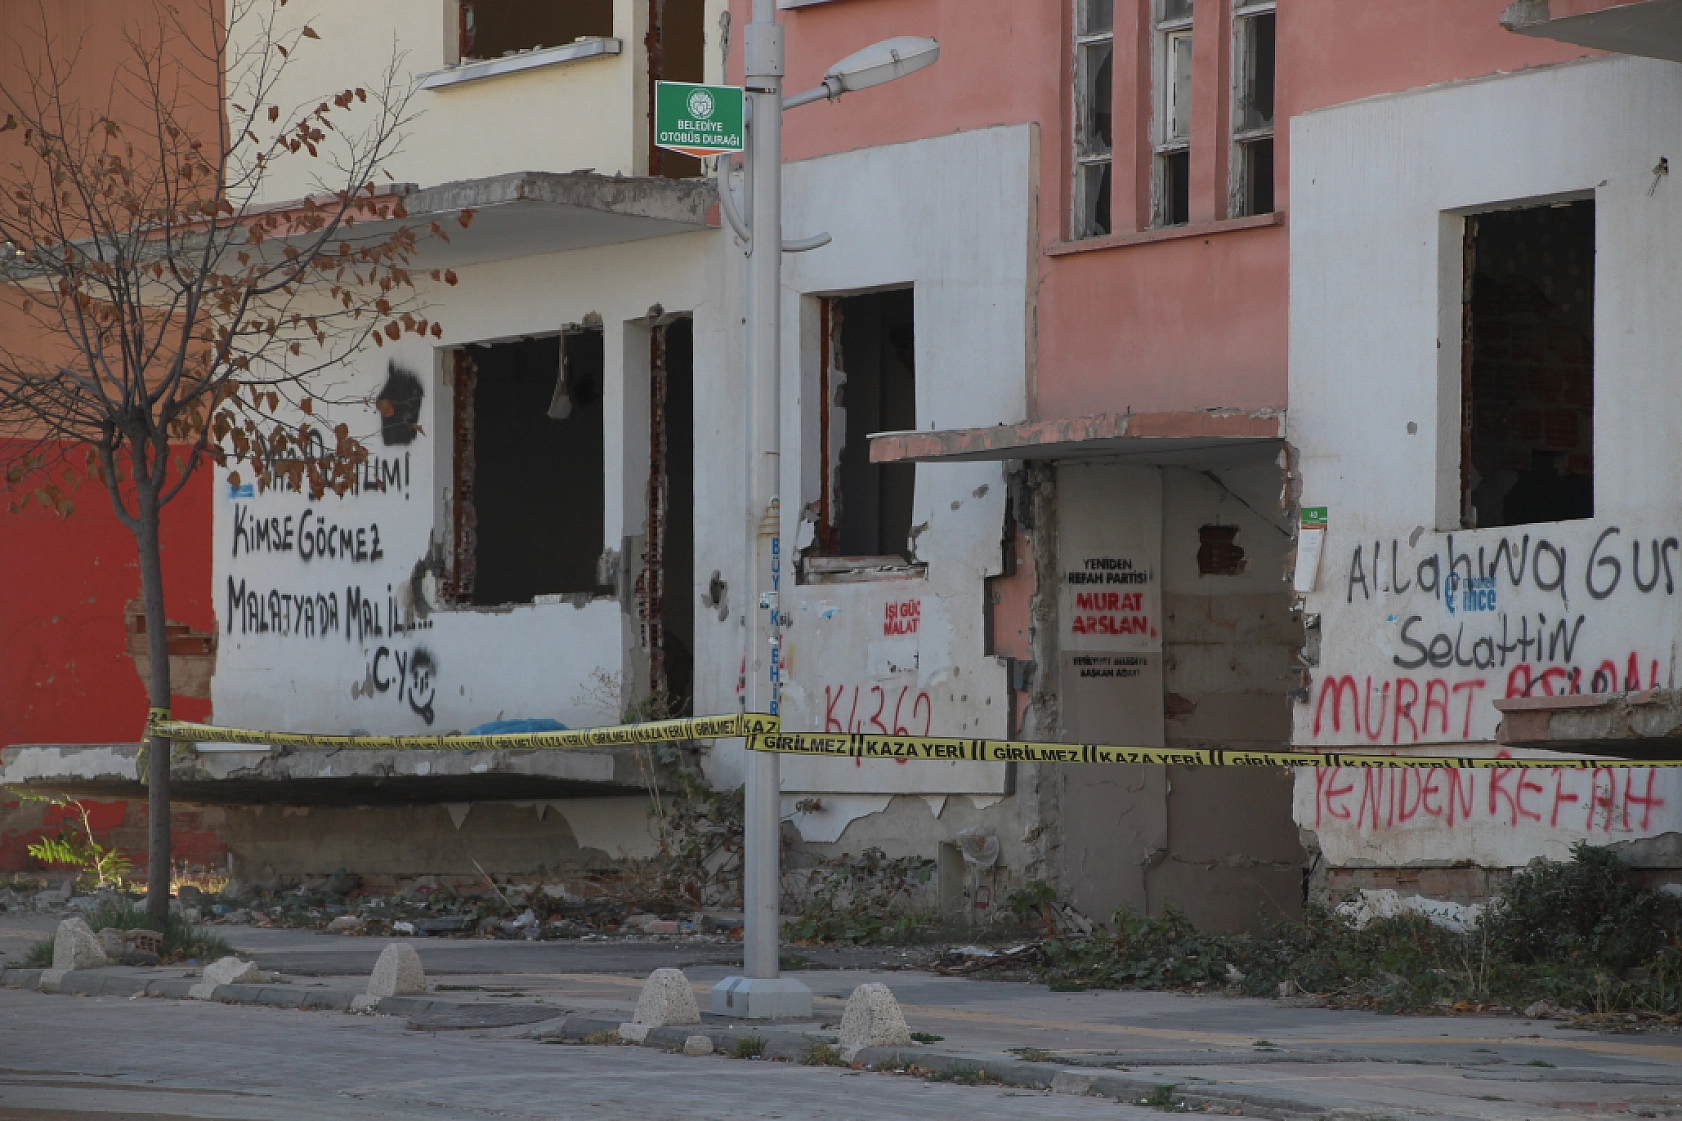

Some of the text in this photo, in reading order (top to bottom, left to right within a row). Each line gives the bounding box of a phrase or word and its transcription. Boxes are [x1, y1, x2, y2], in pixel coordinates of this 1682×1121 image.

[677, 120, 723, 132] BELEDİYE
[660, 131, 740, 146] OTOBÜS DURAĞI
[1083, 555, 1132, 570] YENİDEN
[1068, 570, 1148, 585] REFAH PARTİSİ
[1076, 593, 1144, 611] MURAT
[1072, 616, 1148, 635] ARSLAN
[1313, 675, 1486, 744] MURAT
[744, 719, 778, 735] KAZ
[764, 734, 846, 754] GİRİLMEZ
[867, 741, 919, 756] KAZA
[921, 741, 965, 759] YERİ
[993, 744, 1078, 762] GİRİLMEZ
[1099, 751, 1155, 764] KAZA
